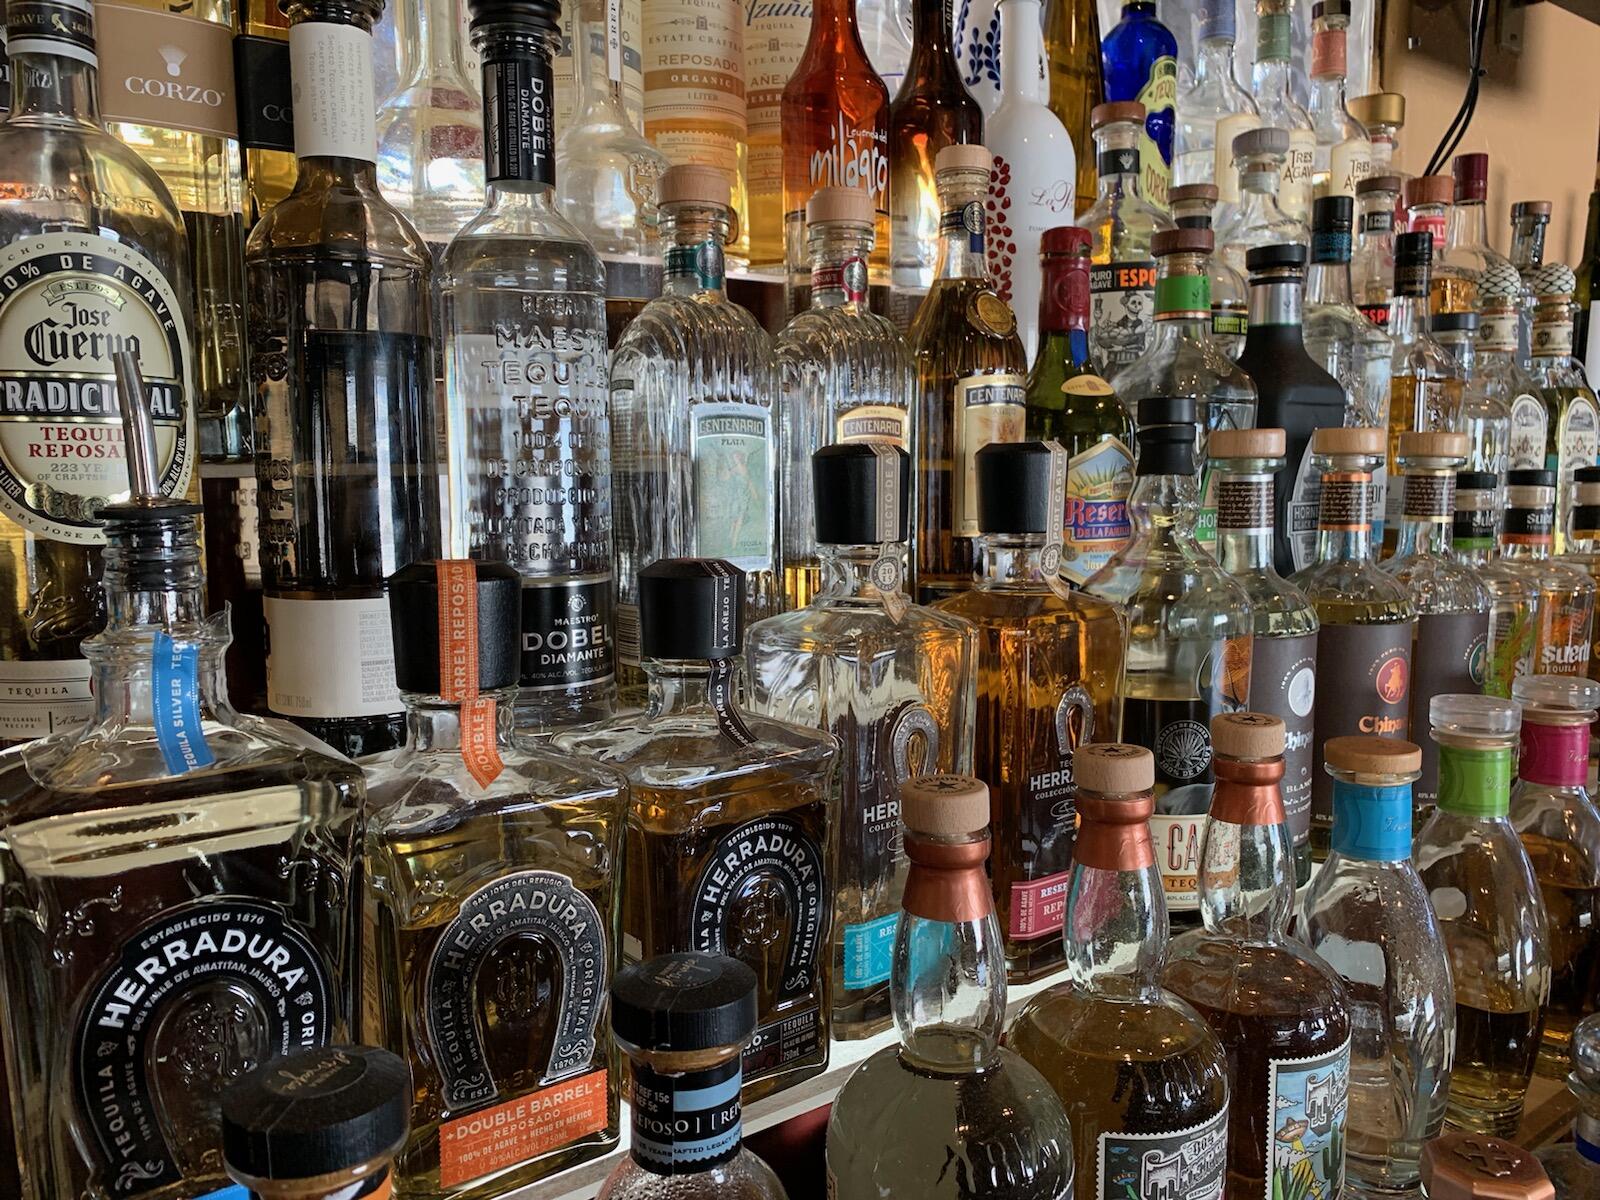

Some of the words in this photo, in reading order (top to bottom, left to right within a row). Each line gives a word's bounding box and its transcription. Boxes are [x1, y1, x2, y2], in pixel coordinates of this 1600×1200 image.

[649, 33, 692, 44] ESTATE
[658, 54, 738, 73] REPOSADO
[125, 76, 222, 107] CORZO
[671, 74, 733, 88] ORGANIC
[520, 89, 531, 149] DIAMANTE
[531, 77, 546, 166] DOBEL
[809, 110, 888, 199] milagro
[1290, 150, 1312, 164] TRES
[1350, 159, 1371, 173] TRES
[1283, 167, 1312, 184] AGAV
[64, 240, 89, 248] EN
[1090, 269, 1111, 281] PURO
[60, 255, 93, 271] DE
[113, 266, 175, 331] AGAVE
[61, 302, 112, 330] Jose
[40, 427, 125, 442] TEQUIL
[700, 417, 764, 436] CENTENARIO
[843, 418, 900, 436] CENTENARIO
[28, 444, 127, 459] REPOSA
[721, 438, 745, 446] PLATA
[51, 463, 78, 473] 223
[885, 470, 895, 489] DE
[42, 525, 83, 539] JOSE
[451, 565, 467, 641] REPOSAD
[555, 614, 597, 627] MAESTRO
[522, 624, 613, 652] DOBEL
[541, 647, 605, 666] DIAMANTE
[8, 687, 69, 697] TEQUILA
[171, 678, 184, 728] SILVER
[179, 731, 198, 772] TEQUILA
[1160, 760, 1179, 776] 100%
[727, 823, 776, 848] ESTABLECIDO
[702, 834, 811, 904] HERRADURA
[726, 869, 745, 894] VALLE
[472, 892, 490, 907] SAN
[490, 882, 511, 896] JOSE
[512, 878, 528, 888] DEL
[529, 876, 564, 888] REFUGIO
[141, 912, 231, 950] ESTABLECIDO
[443, 890, 588, 975] HERRADURA
[474, 929, 495, 957] VALLE
[495, 922, 508, 937] DE
[799, 897, 818, 967] ORIGINAL
[98, 929, 306, 1029] HERRADURA
[145, 980, 174, 1010] VALLE
[174, 970, 190, 984] DE
[249, 967, 280, 999] JALISCO
[573, 957, 596, 1036] ORIGINAL
[783, 1013, 814, 1032] TEQUILA
[442, 997, 468, 1075] TEQUILA
[553, 1057, 575, 1071] 1870
[125, 1061, 138, 1098] AGAVE
[470, 1087, 491, 1100] EST.
[98, 1063, 137, 1158] TEQUILA
[456, 1105, 527, 1142] DOUBLE
[530, 1084, 594, 1115] BARREL
[493, 1107, 562, 1140] REPOSADO
[458, 1149, 482, 1165] 100%
[494, 1135, 519, 1154] AGAVE
[530, 1123, 554, 1142] HECHO
